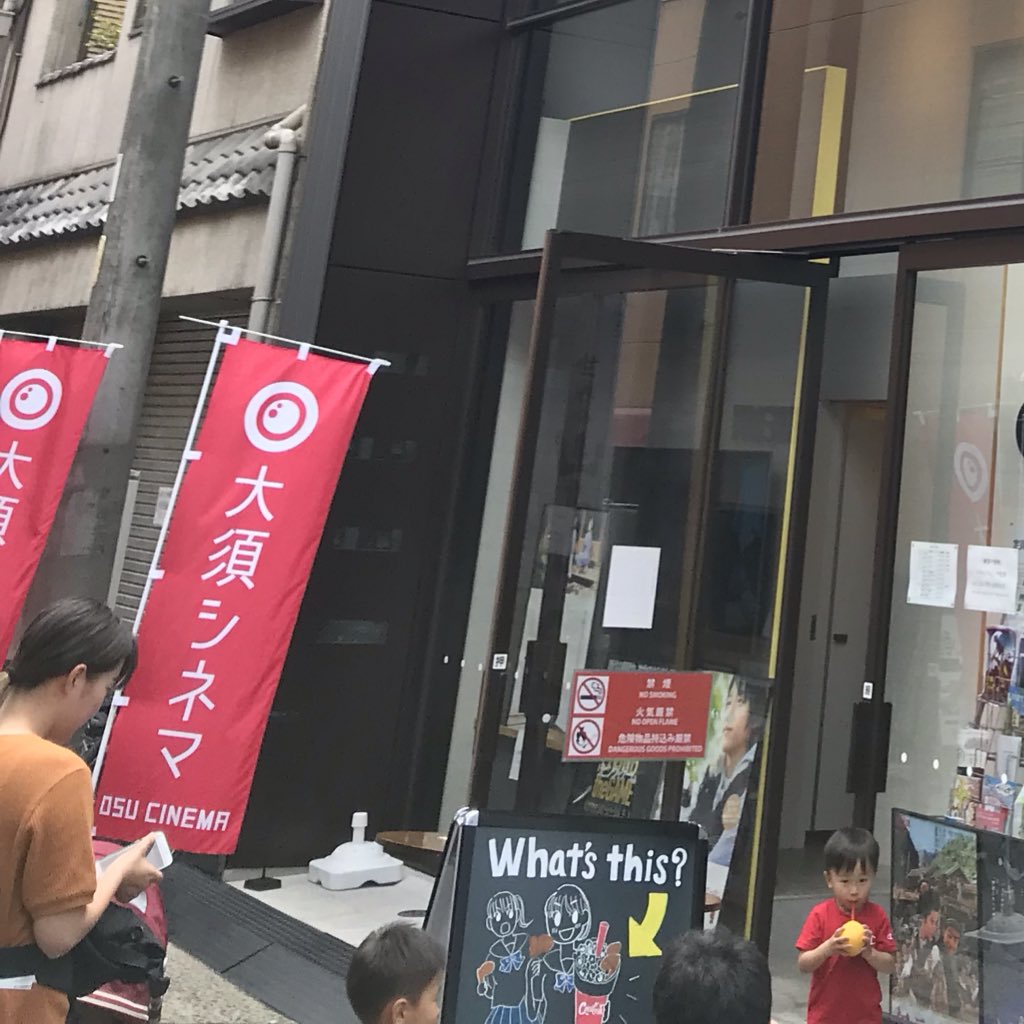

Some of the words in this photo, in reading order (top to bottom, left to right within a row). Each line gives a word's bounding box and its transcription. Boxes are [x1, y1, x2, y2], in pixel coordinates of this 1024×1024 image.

[158, 465, 285, 780] 大須シネマ
[639, 691, 648, 699] NO
[649, 691, 677, 699] SMOKING
[635, 706, 675, 718] 火気厳禁
[631, 718, 641, 726] NO
[642, 718, 658, 726] OPEN
[659, 718, 678, 726] FLAME
[608, 745, 645, 754] DANGEROUS
[646, 745, 668, 754] GOODS
[668, 745, 703, 754] PROHIBITED
[99, 794, 140, 821] OSU
[144, 802, 231, 832] CINEMA
[488, 836, 598, 880] What's
[606, 843, 688, 888] this?
